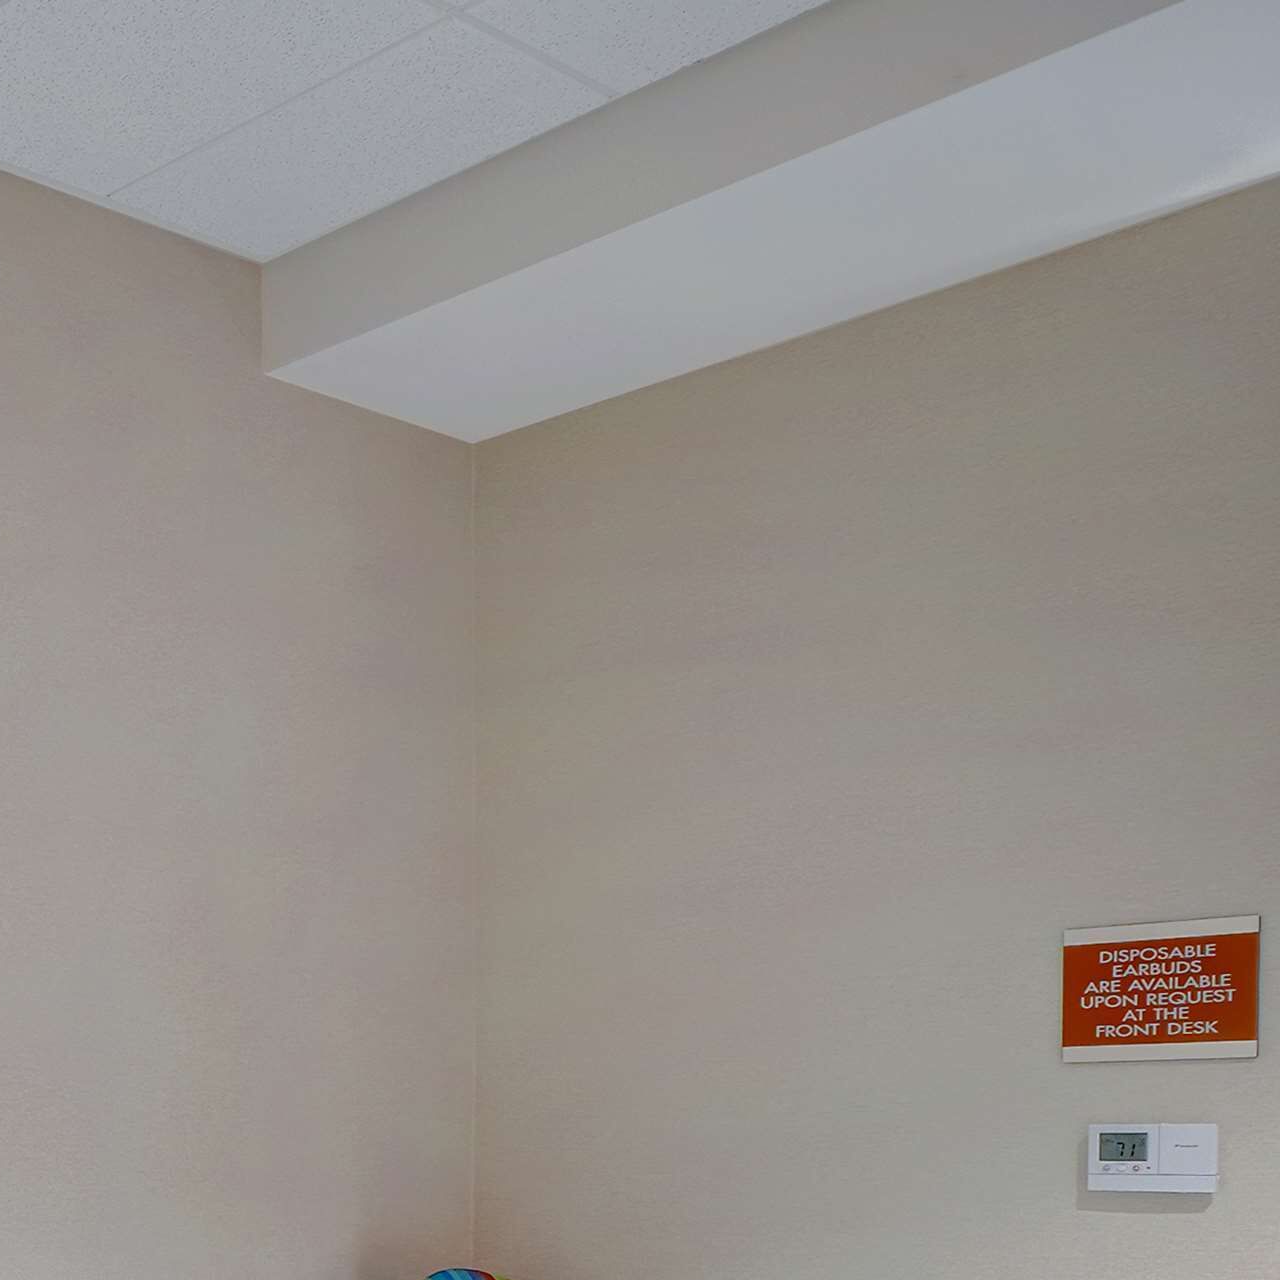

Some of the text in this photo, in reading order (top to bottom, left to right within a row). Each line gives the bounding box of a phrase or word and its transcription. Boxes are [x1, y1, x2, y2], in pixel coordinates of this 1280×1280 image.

[1099, 944, 1217, 964] DISPOSABLE
[1112, 960, 1202, 978] EARBUDS
[1084, 974, 1232, 995] ARE AVAILABLE
[1080, 989, 1236, 1009] UPON REQUEST
[1122, 1006, 1189, 1022] AT THE
[1095, 1021, 1218, 1038] FRONT DESK
[1116, 1142, 1136, 1157] 71
